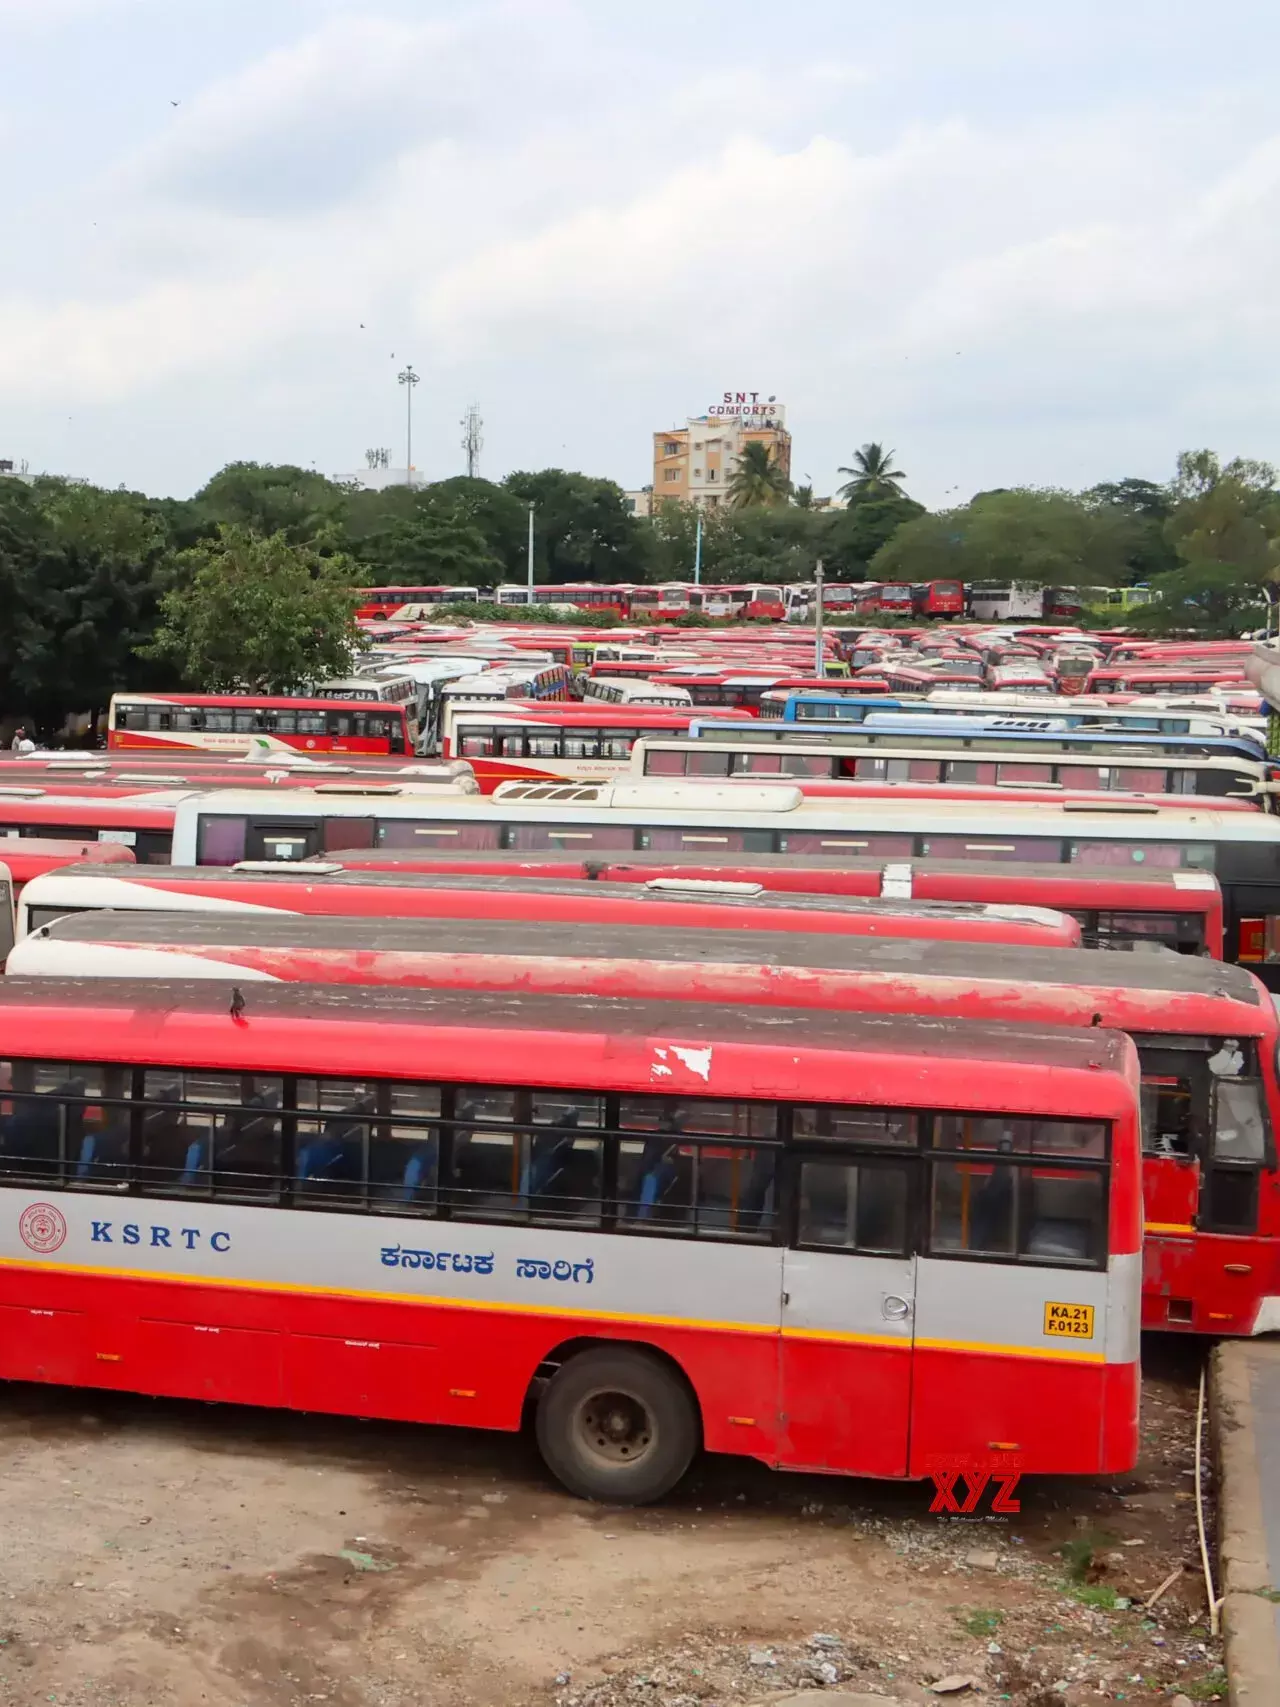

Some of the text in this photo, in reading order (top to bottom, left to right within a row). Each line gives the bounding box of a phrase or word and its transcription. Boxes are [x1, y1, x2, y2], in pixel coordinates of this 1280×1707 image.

[723, 392, 759, 404] SNT
[708, 405, 776, 416] COMFORTS
[91, 1221, 232, 1252] KSRTC
[380, 1243, 595, 1284] ಕರ್ನಾಟಕ ಸಾರಿಗೆ
[1050, 1306, 1088, 1320] KA.21
[1048, 1319, 1089, 1334] F.0123
